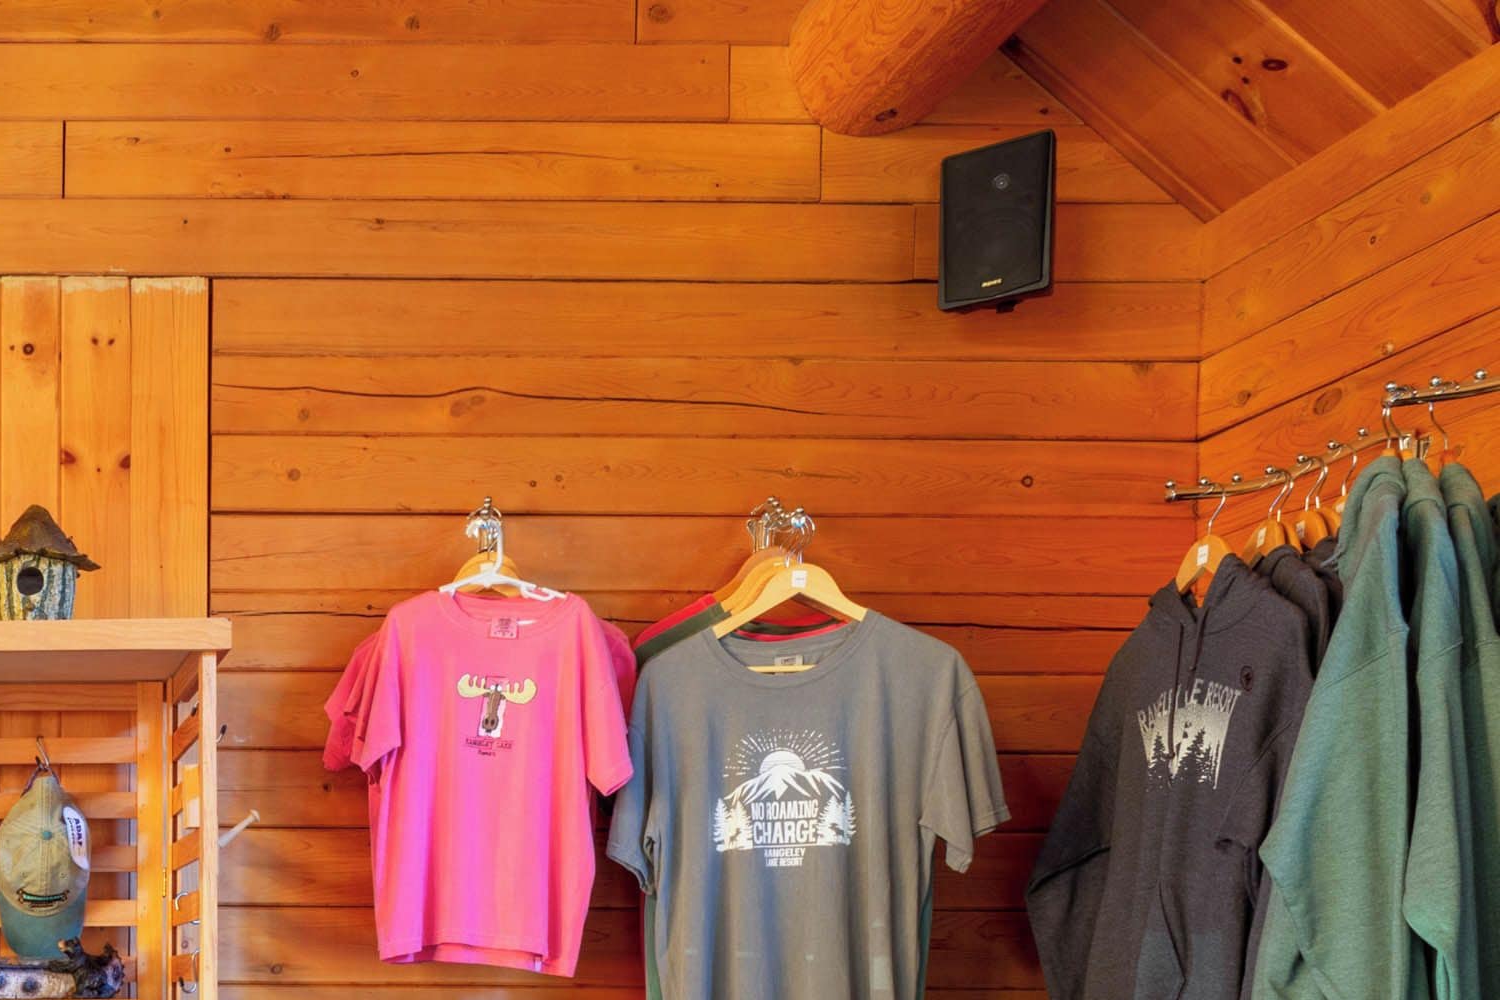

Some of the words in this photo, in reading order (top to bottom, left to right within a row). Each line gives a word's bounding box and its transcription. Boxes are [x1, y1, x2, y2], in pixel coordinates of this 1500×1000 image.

[751, 801, 764, 821] NO
[765, 799, 819, 821] ROAMING
[752, 819, 818, 845] CHARGE
